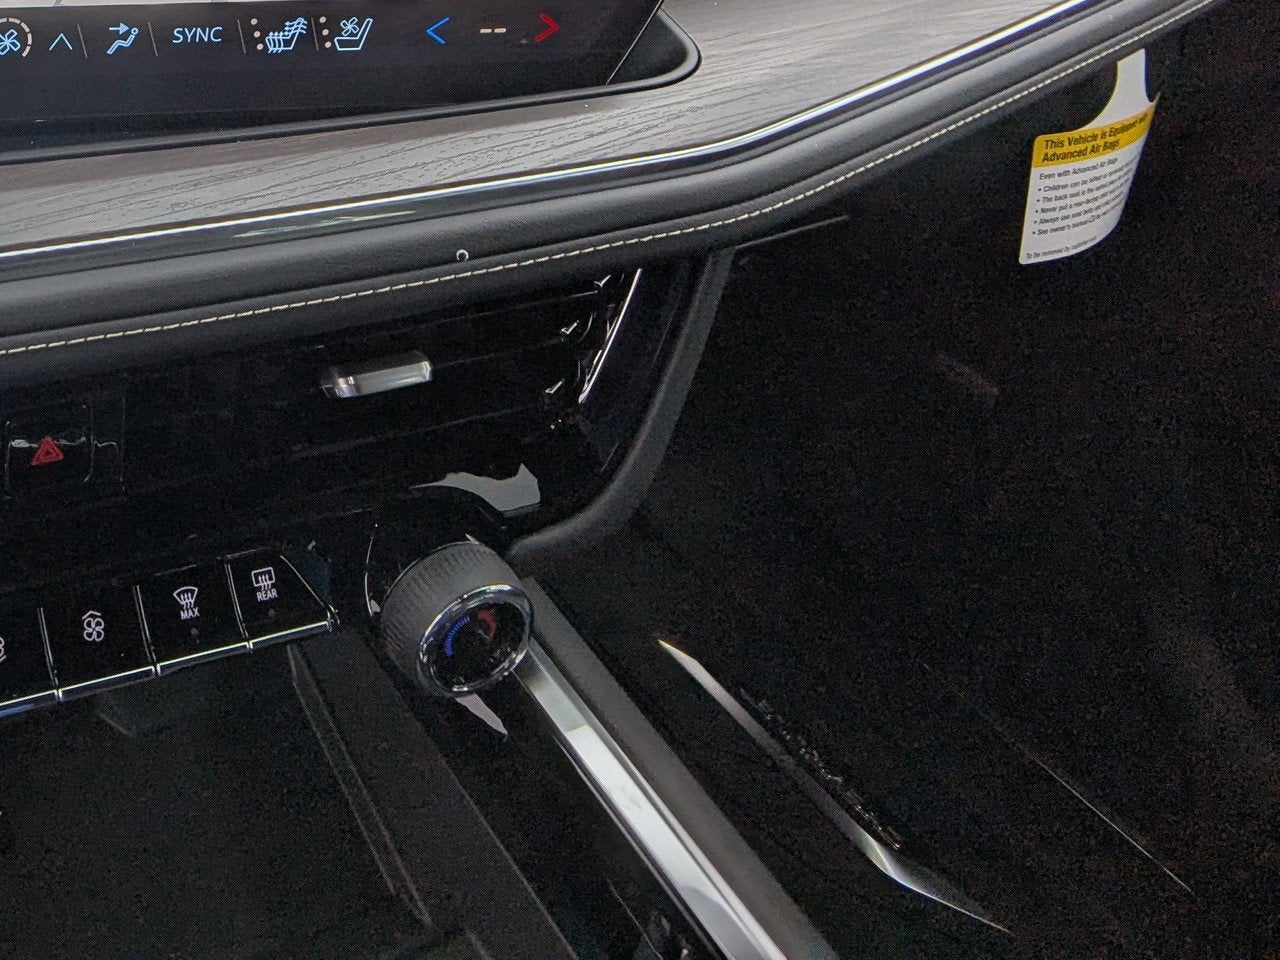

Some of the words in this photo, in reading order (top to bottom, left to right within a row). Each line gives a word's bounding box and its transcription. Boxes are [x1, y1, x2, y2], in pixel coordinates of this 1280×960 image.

[172, 25, 222, 45] SYNC
[1045, 139, 1064, 150] This
[1068, 134, 1098, 146] Vehicle
[1101, 129, 1107, 139] is
[1042, 147, 1088, 163] Advanced
[1089, 141, 1101, 155] Air
[256, 587, 278, 602] REAR
[180, 606, 201, 620] MAX
